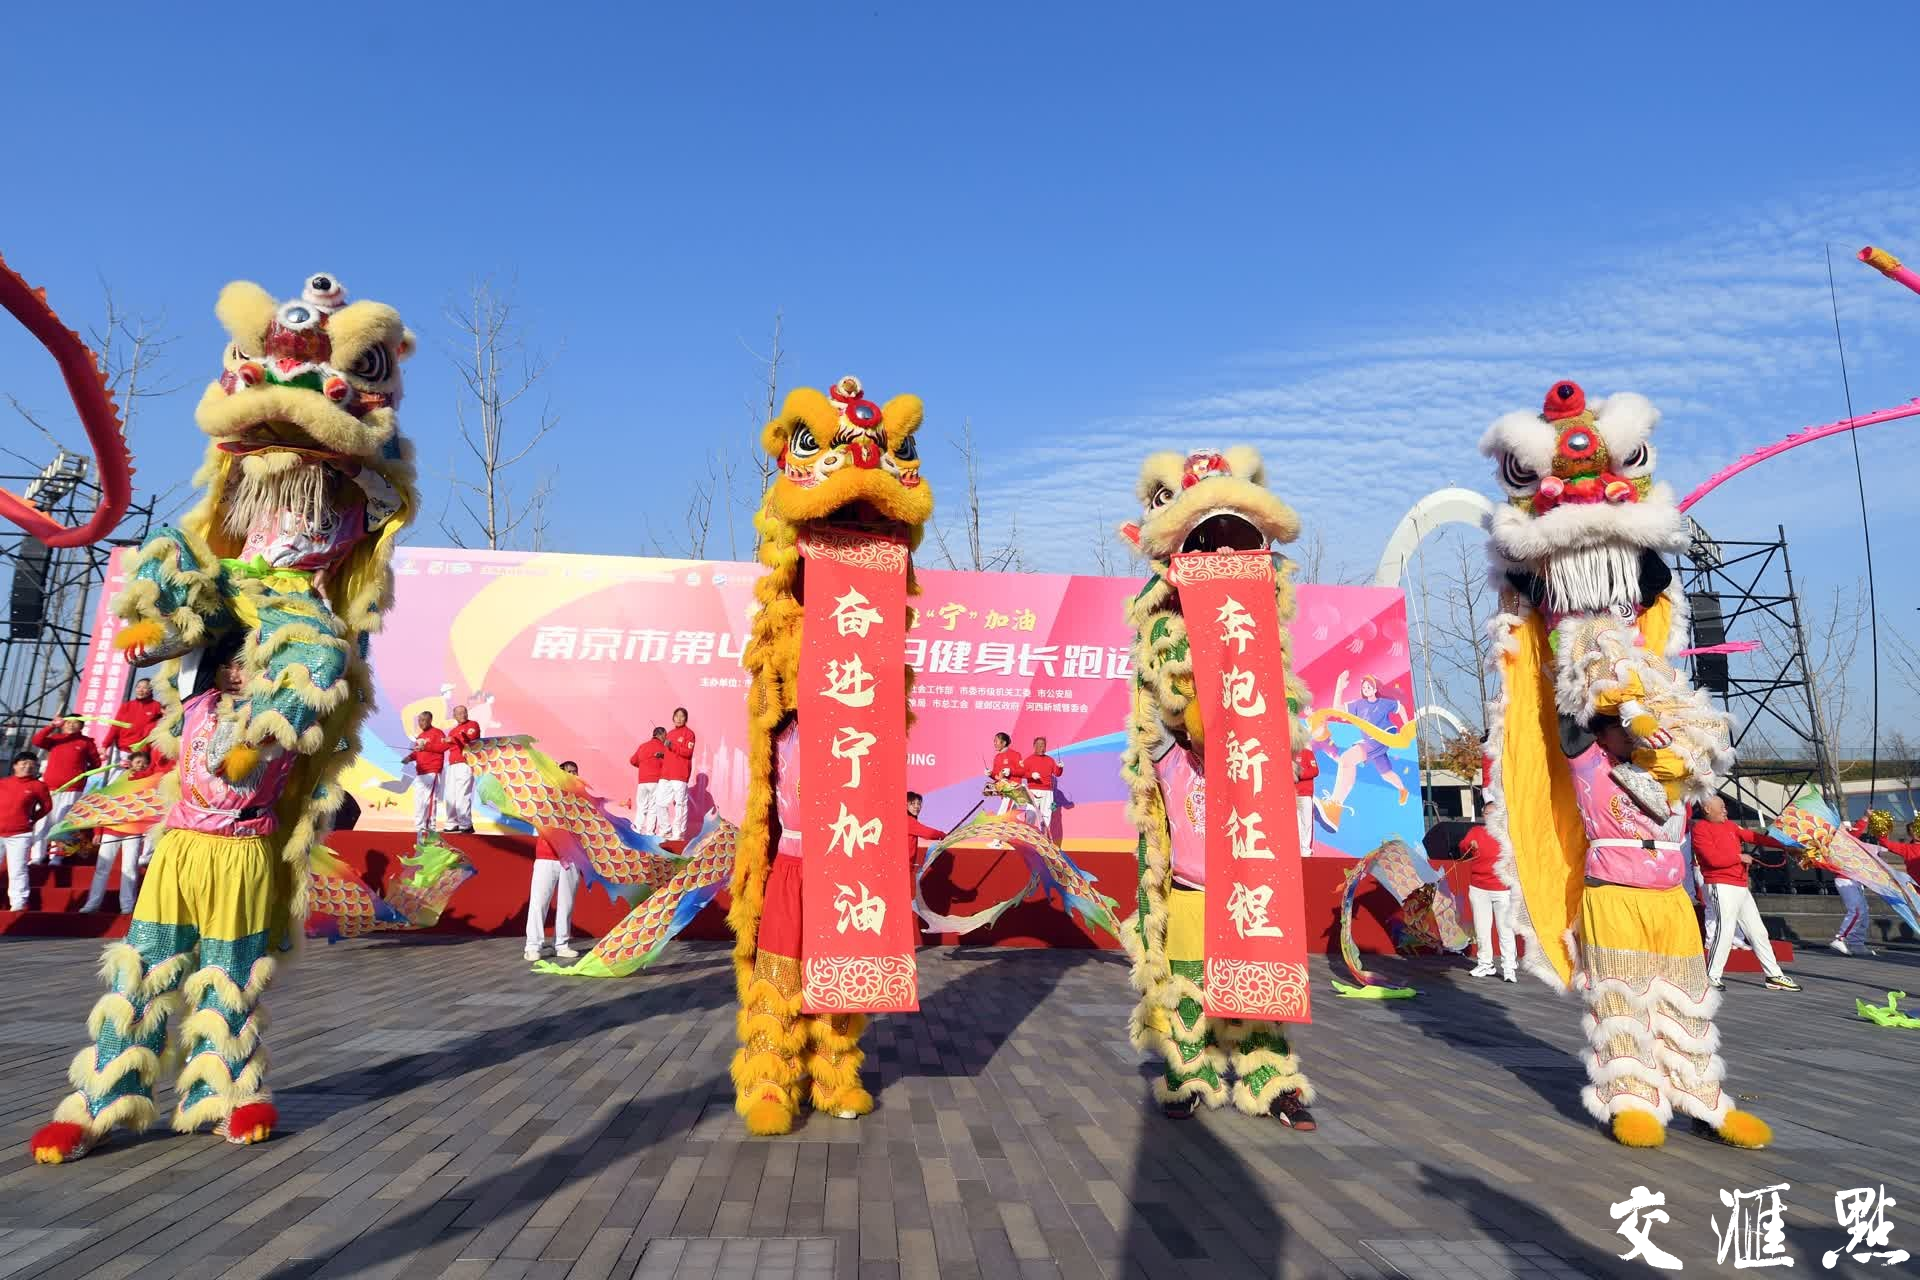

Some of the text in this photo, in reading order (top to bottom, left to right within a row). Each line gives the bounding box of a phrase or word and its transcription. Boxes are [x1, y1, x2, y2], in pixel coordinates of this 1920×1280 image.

[819, 585, 887, 936] 奋进宁加油
[1214, 594, 1284, 940] 奔跑新征程
